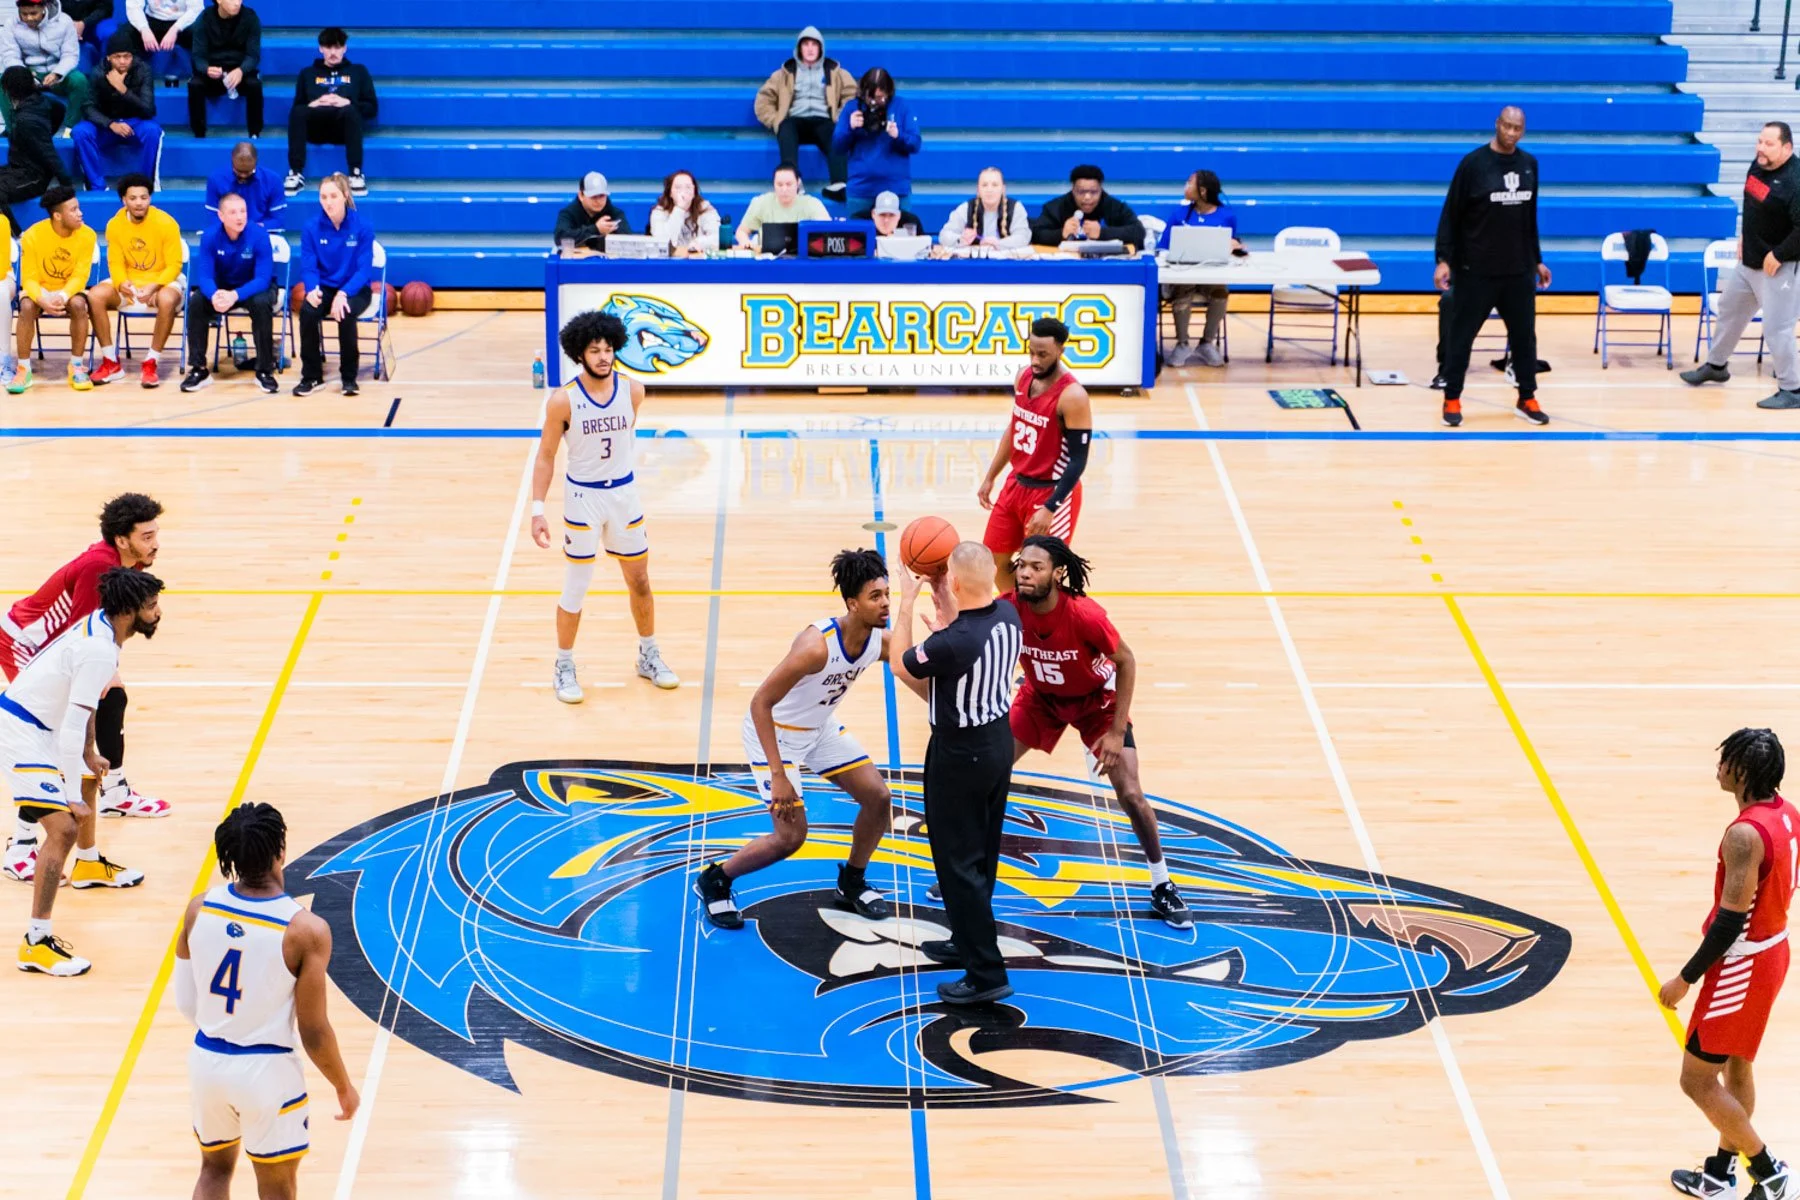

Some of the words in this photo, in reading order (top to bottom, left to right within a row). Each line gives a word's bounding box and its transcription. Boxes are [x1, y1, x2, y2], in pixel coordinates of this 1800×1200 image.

[827, 237, 846, 253] POSS
[740, 293, 1116, 369] BEARCATS
[806, 363, 900, 376] BRESCIA
[582, 415, 628, 435] BRESCIA
[600, 437, 612, 460] 3
[1013, 420, 1038, 455] 23
[1020, 645, 1079, 662] OUTHEAST
[1031, 659, 1065, 685] 15
[210, 948, 242, 1015] 4
